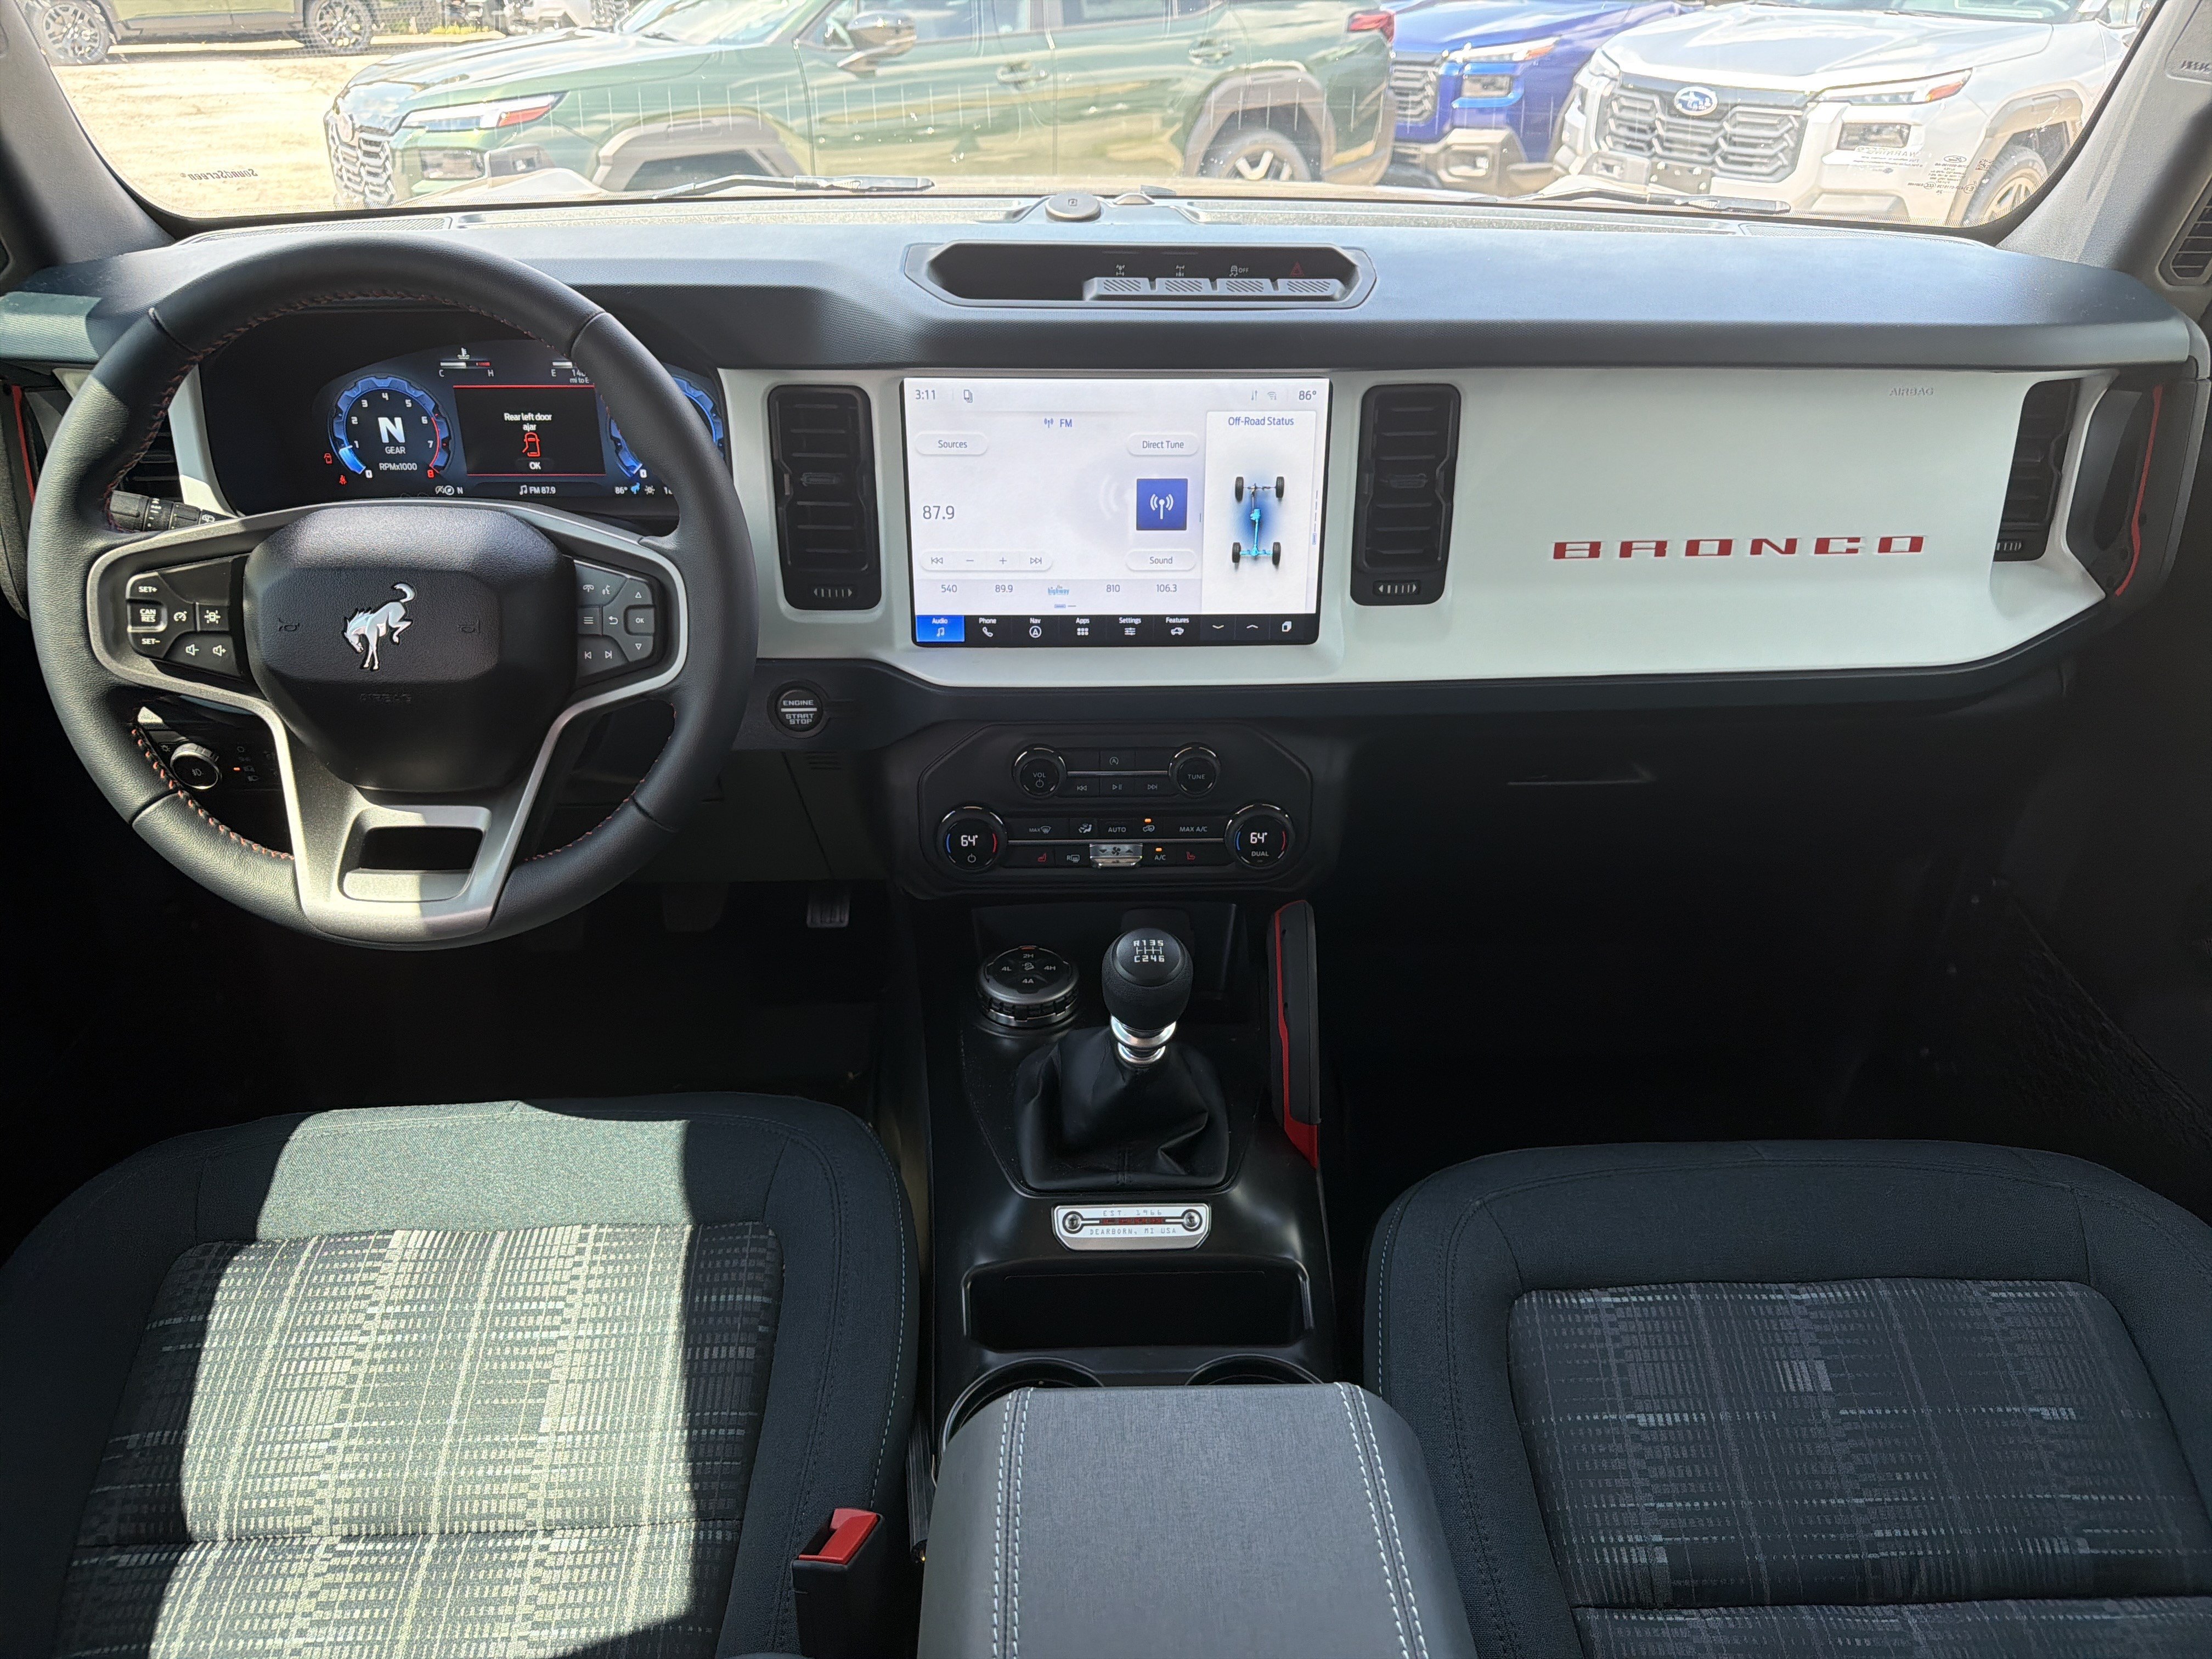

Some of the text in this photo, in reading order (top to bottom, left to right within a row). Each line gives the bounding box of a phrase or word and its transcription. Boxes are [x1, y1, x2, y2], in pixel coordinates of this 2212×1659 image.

[382, 392, 388, 400] 4
[915, 390, 936, 400] 3:11
[1298, 390, 1317, 400] 86°
[1889, 387, 1934, 396] AIRBAG
[362, 399, 368, 408] 3
[405, 399, 412, 408] 5
[421, 416, 428, 424] 6
[504, 412, 552, 421] Rear left door
[1228, 416, 1294, 426] Off-Road Status
[523, 423, 537, 432] ajar
[1059, 419, 1073, 427] FM
[378, 417, 405, 443] N
[938, 440, 968, 449] Sources
[1142, 441, 1184, 449] Direct Tune
[379, 462, 417, 471] RPMx1000
[529, 461, 541, 470] OK
[365, 470, 373, 478] 0
[427, 470, 435, 478] 8
[640, 470, 647, 478] 0
[540, 486, 556, 494] 87.9
[614, 486, 628, 494] 86°
[923, 505, 955, 520] 87.9
[1553, 536, 1924, 560] BRONCO
[1149, 556, 1173, 565] Sound
[941, 584, 957, 592] 540
[995, 584, 1013, 593] 89.9
[1048, 586, 1069, 595] highway
[1106, 584, 1120, 592] 810
[1156, 584, 1177, 592] 106.3
[961, 834, 978, 847] 64°
[1250, 832, 1268, 844] 64°
